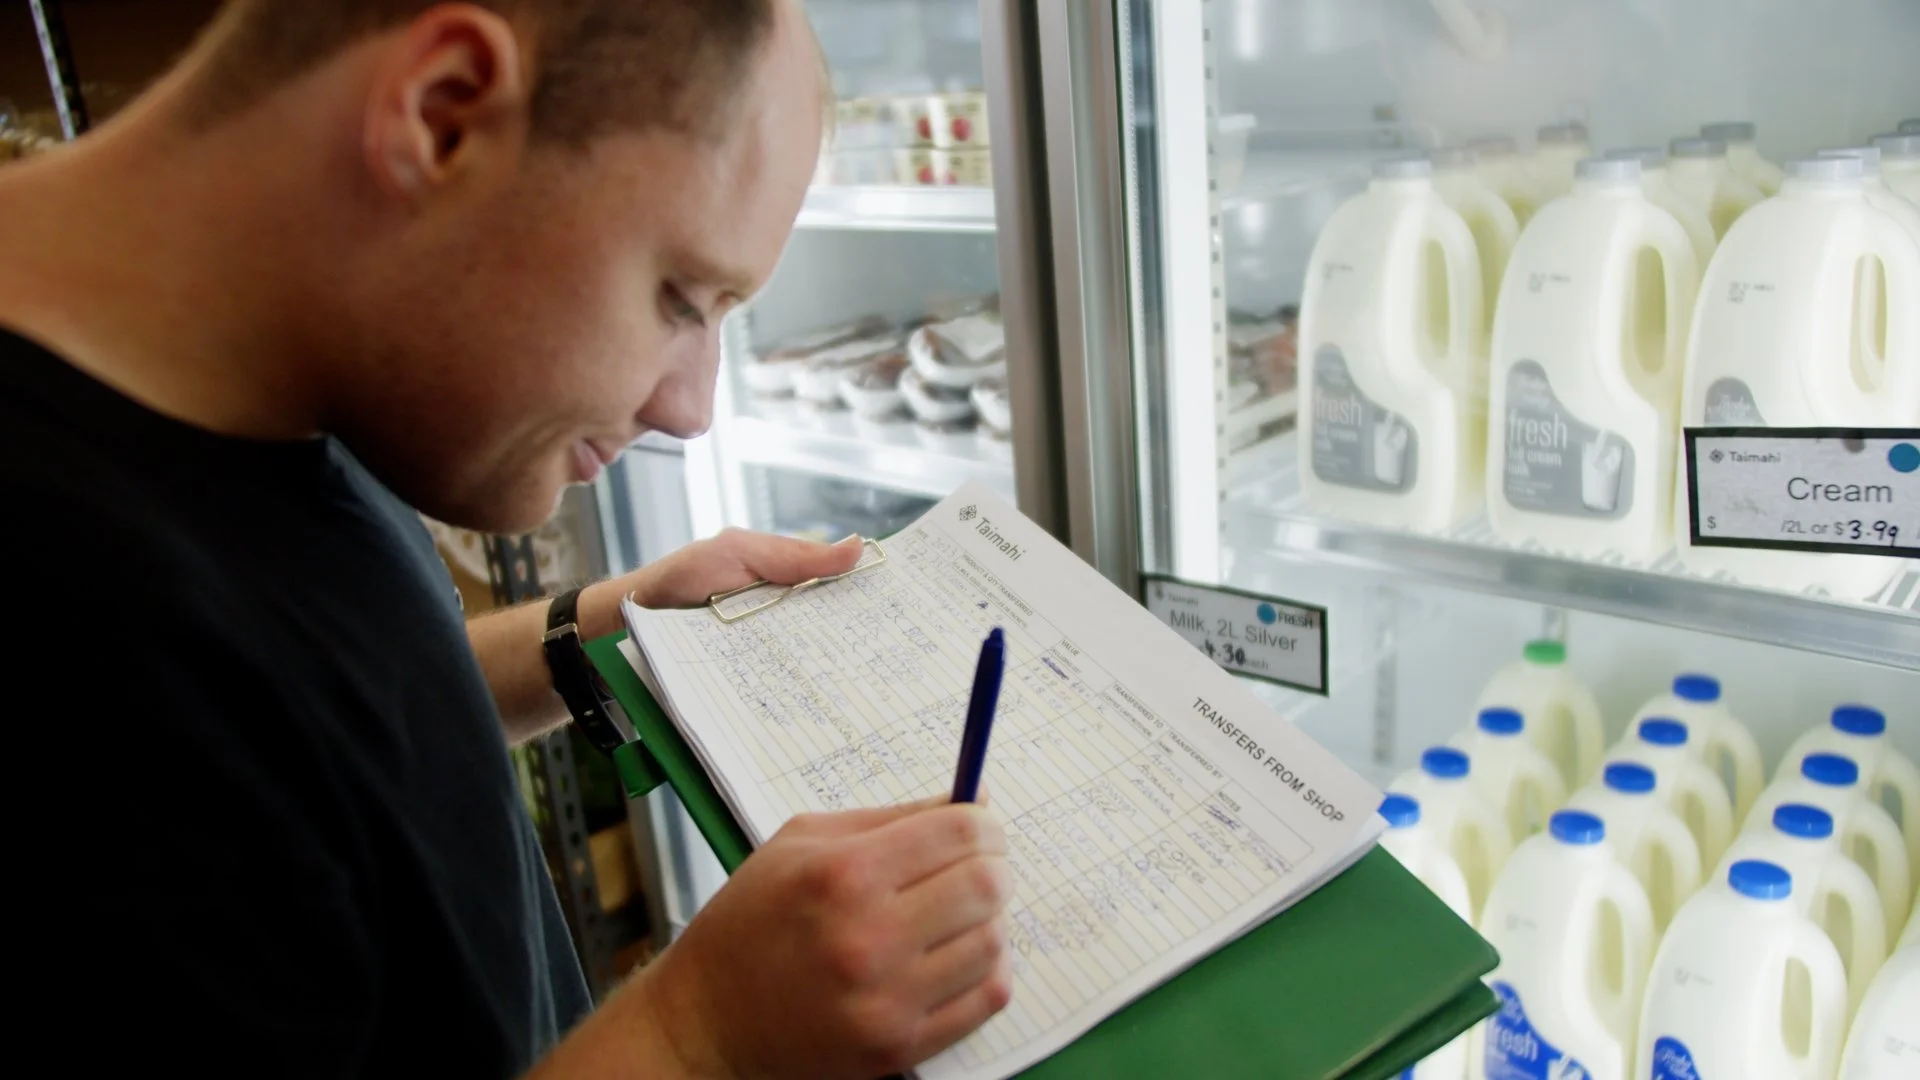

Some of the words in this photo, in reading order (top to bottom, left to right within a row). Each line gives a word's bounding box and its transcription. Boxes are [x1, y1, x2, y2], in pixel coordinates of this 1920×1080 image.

[1509, 409, 1567, 450] fresh
[1729, 451, 1781, 464] Taimahi
[1786, 476, 1893, 503] Cream
[976, 516, 1026, 562] Taimahi
[1706, 516, 1717, 530] $
[1811, 524, 1829, 535] or
[1170, 609, 1211, 634] Milk,
[1217, 619, 1238, 639] 2L
[1245, 624, 1299, 652] Silver
[1278, 608, 1313, 629] FRESH
[1111, 683, 1155, 722] TRANSFERRED
[1165, 730, 1215, 772] TRANSFERRED
[1192, 697, 1266, 761] TRANSFERS
[1263, 756, 1306, 793] FROM
[1303, 789, 1346, 822] SHOP
